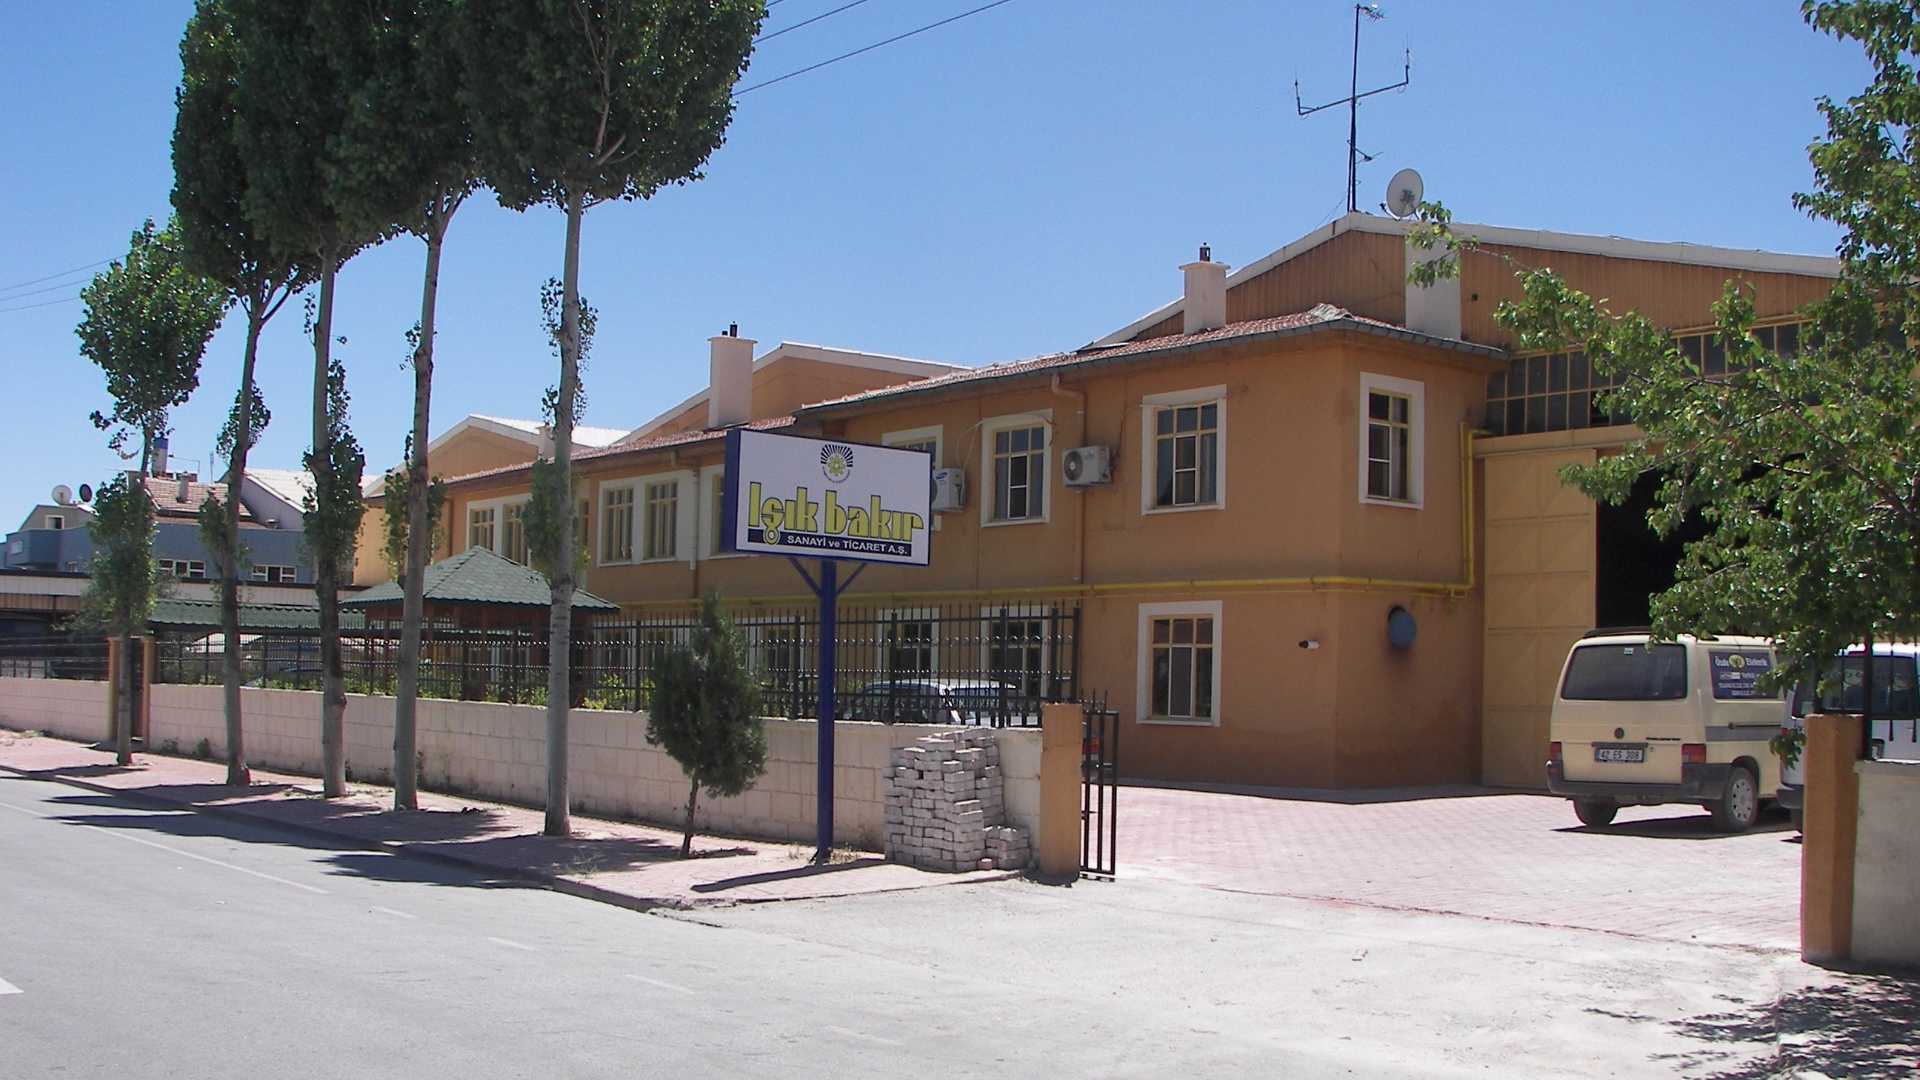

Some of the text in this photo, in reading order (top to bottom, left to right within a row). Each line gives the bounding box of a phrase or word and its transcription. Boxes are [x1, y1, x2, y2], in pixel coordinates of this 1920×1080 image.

[748, 482, 924, 545] Işık bakır
[787, 535, 826, 546] SANAYİ
[828, 540, 841, 548] ve
[843, 539, 885, 552] TİCARET
